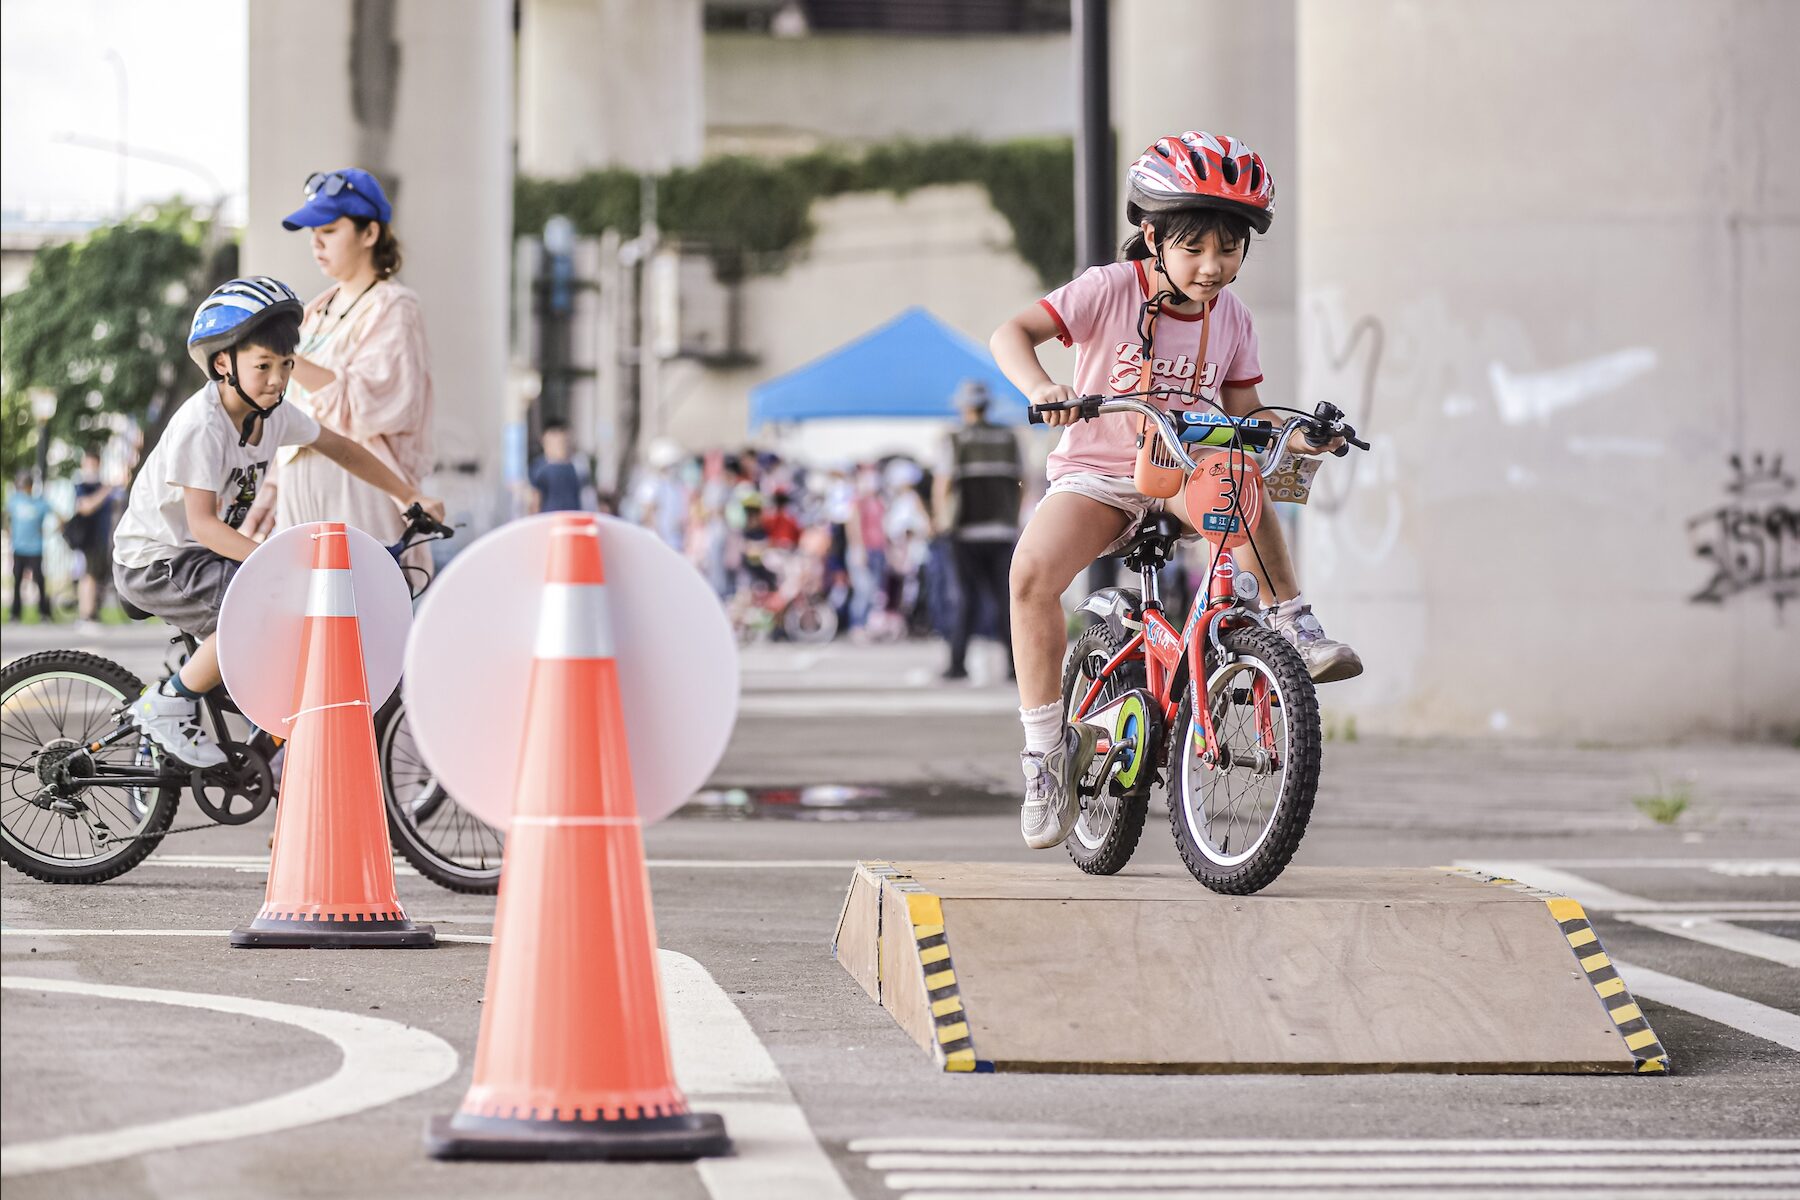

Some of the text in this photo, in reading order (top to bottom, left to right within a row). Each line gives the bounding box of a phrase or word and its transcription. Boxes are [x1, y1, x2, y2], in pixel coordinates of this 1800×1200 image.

[1108, 362, 1197, 405] Grl
[1115, 342, 1217, 386] Baby
[1211, 478, 1237, 513] 3
